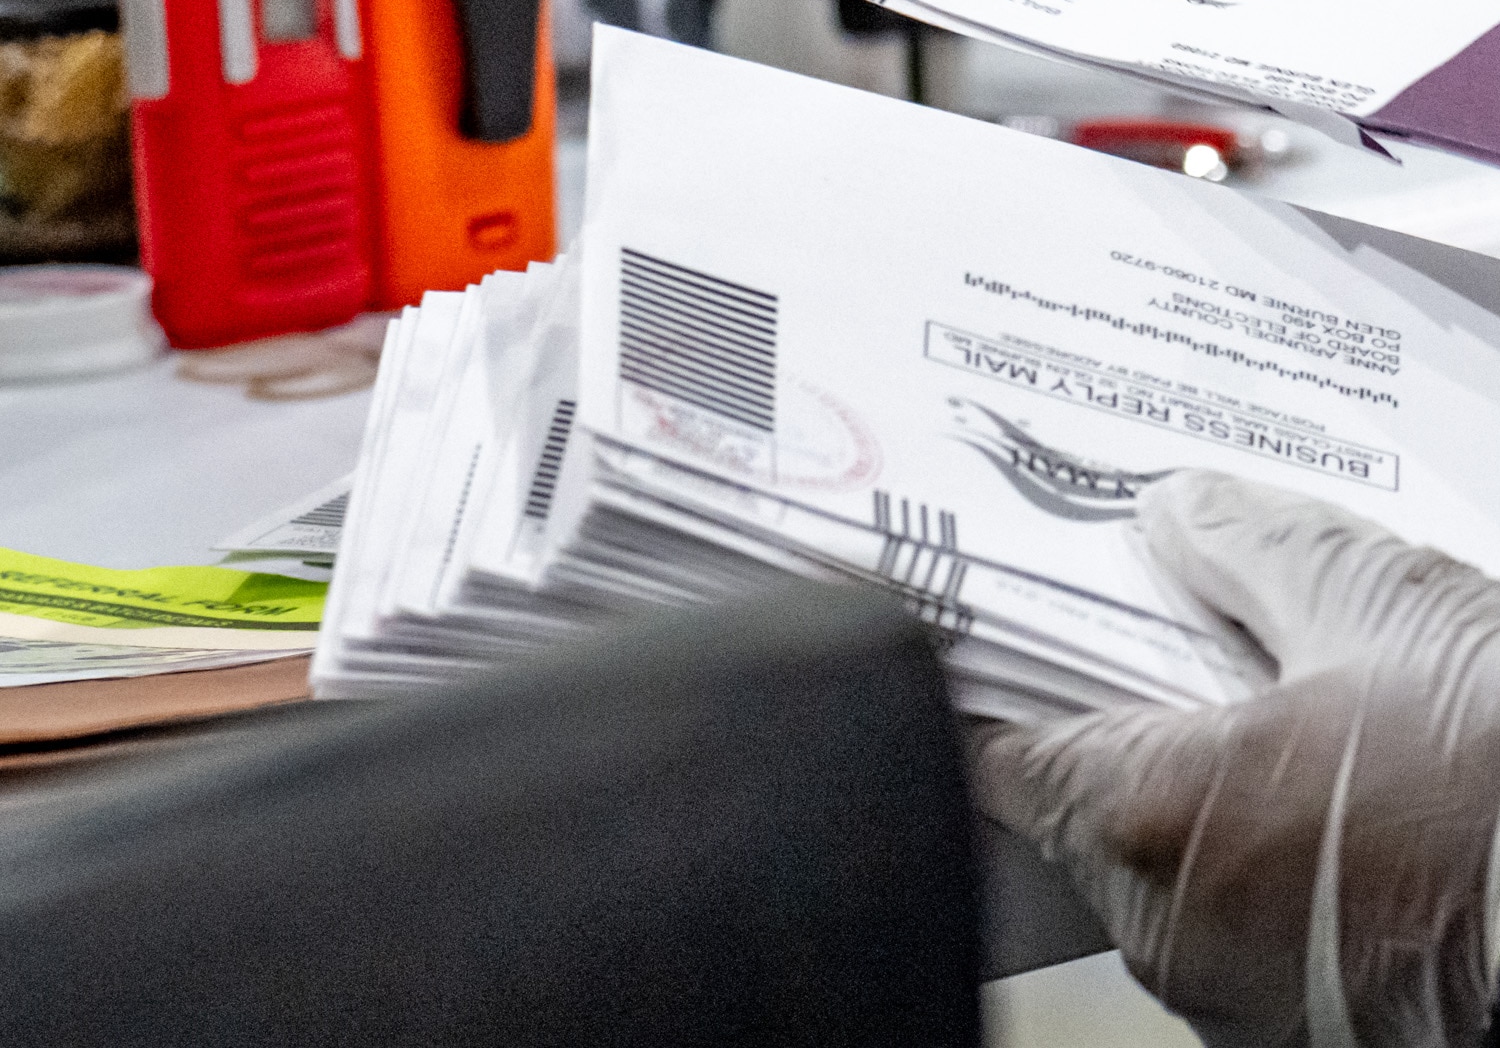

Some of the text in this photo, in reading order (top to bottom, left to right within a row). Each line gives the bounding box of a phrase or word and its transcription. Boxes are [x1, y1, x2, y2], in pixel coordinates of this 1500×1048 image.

[1109, 250, 1402, 341] GLEN BURNIE MD 21060-9720
[944, 331, 973, 345] MD
[1147, 297, 1401, 377] ANNE ARUNDEL COUNTY
[1172, 292, 1400, 366] BOARD OF ELECTIONS
[1282, 313, 1401, 352] PO BOX 490
[999, 332, 1326, 432] POSTAGE WILL BE PAID BY ADDRESSEE
[1047, 362, 1093, 381] GLEN
[954, 345, 1370, 478] BUSINESS REPLY MAIL
[1162, 395, 1223, 419] PERMIT
[1232, 415, 1269, 432] MAIL
